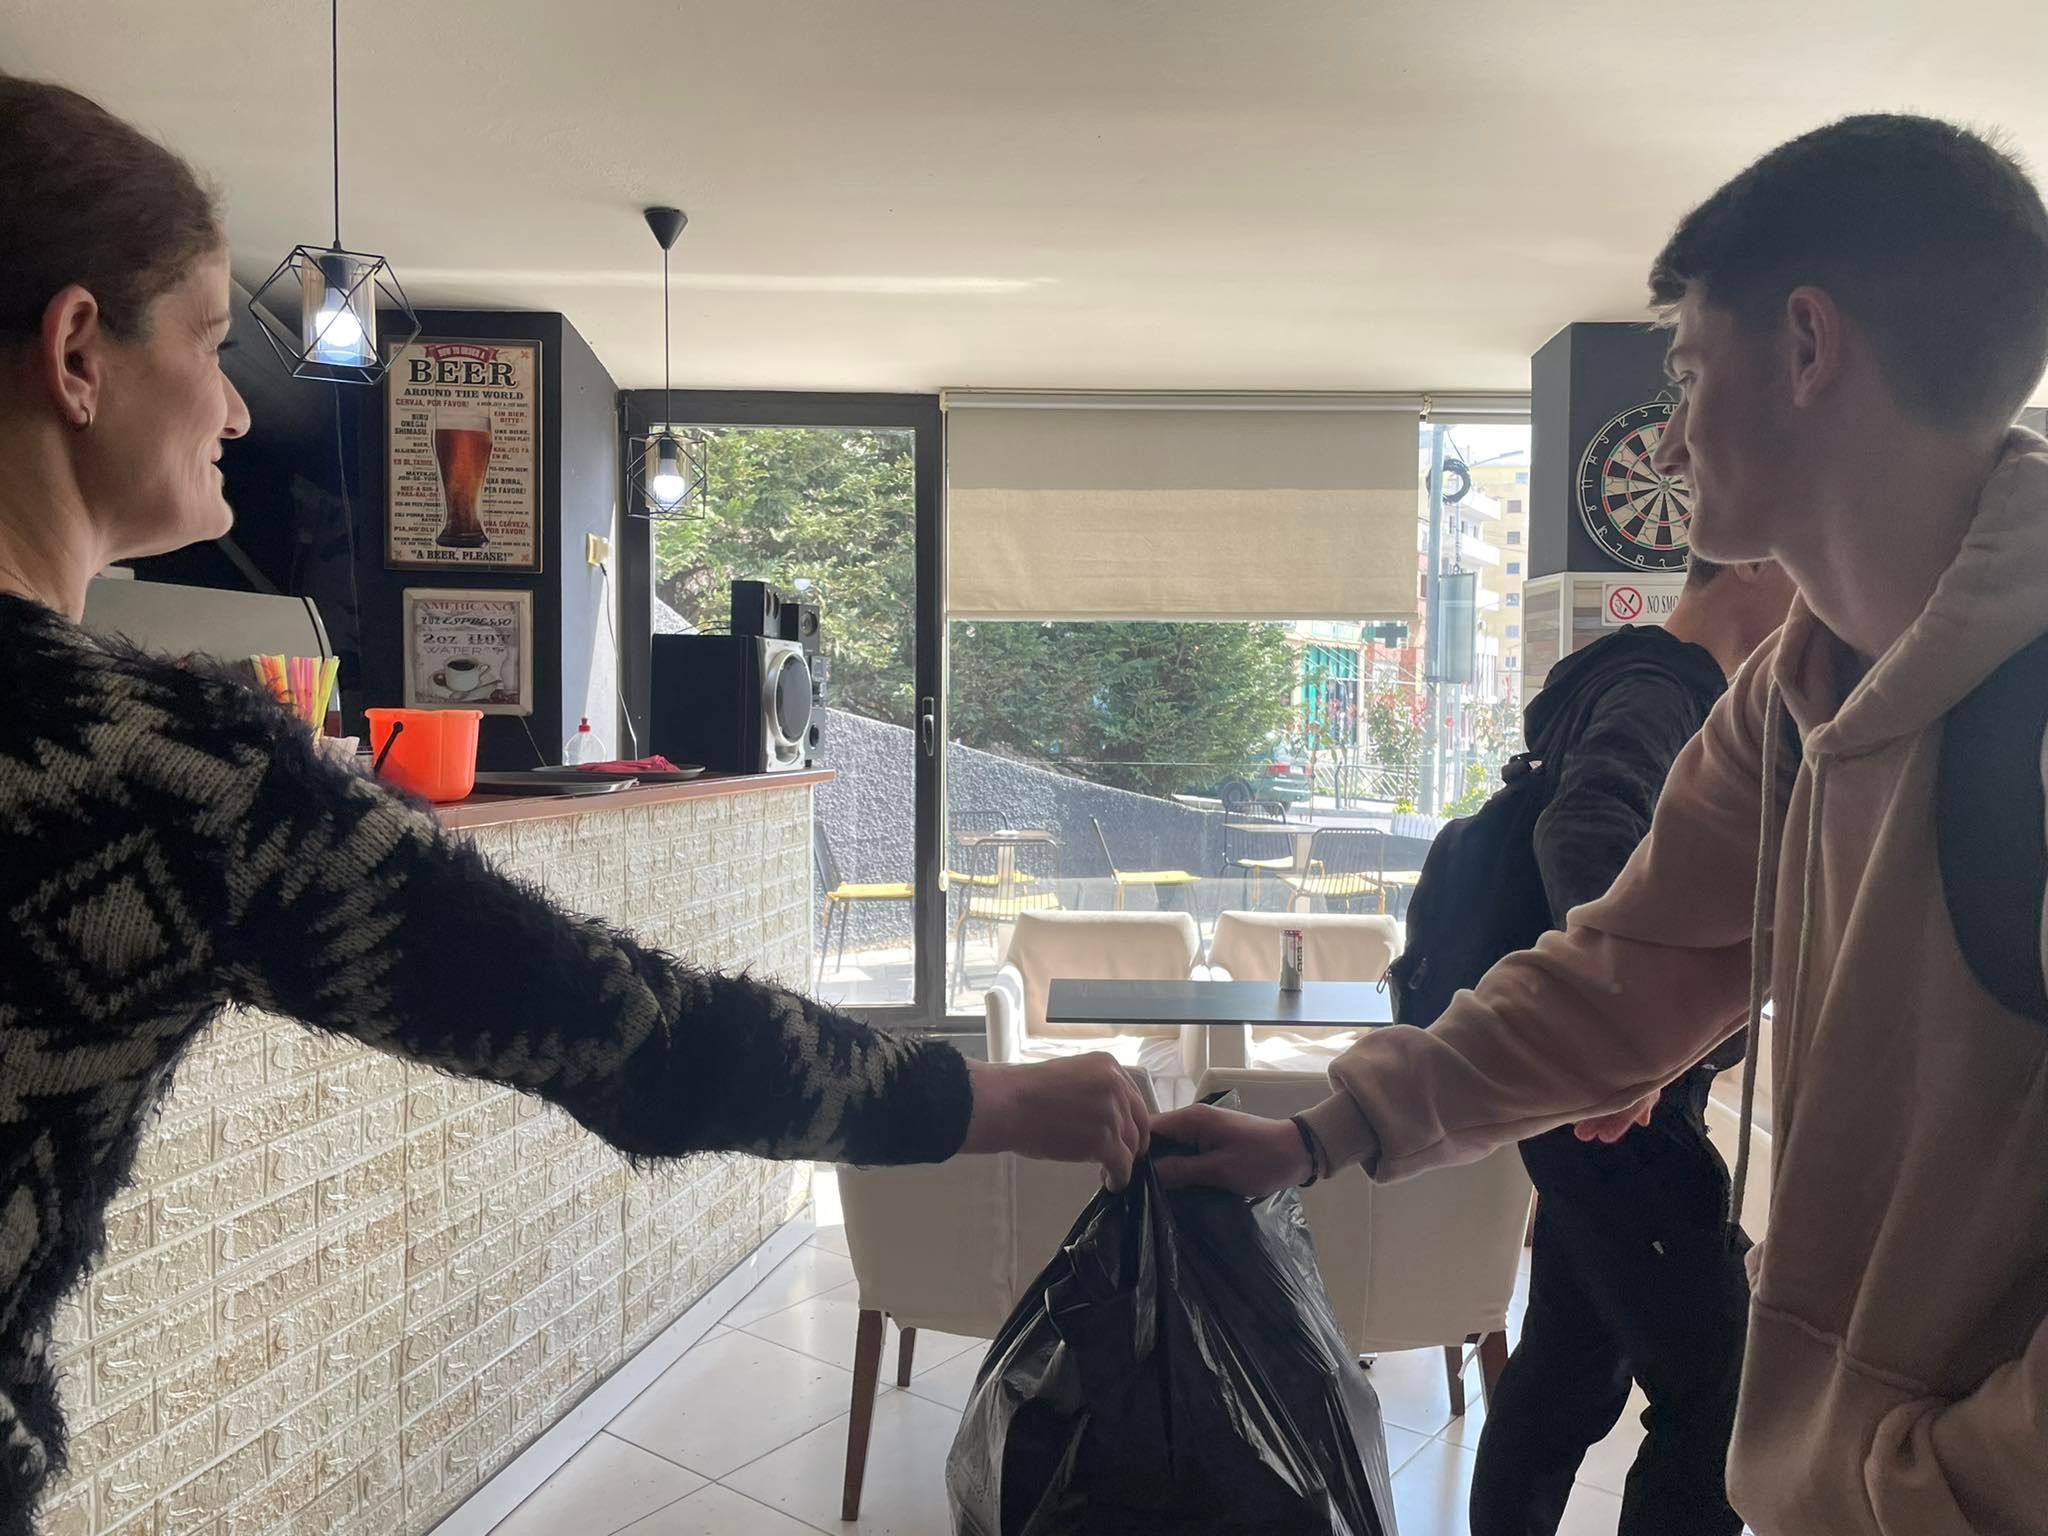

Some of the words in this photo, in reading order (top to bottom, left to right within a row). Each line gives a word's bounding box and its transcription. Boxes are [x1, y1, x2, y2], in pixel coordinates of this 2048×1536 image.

[408, 359, 517, 387] BEER
[404, 388, 452, 397] AROUND
[455, 389, 479, 398] THE
[483, 391, 524, 400] WORLD
[427, 399, 441, 407] POR
[443, 400, 469, 408] FAVOR!
[1640, 408, 1649, 418] 5
[1617, 417, 1629, 428] 12
[486, 477, 499, 485] UNA
[1583, 479, 1593, 488] 11
[499, 487, 526, 495] FAVORE!
[501, 528, 526, 536] FAVOR!
[1614, 543, 1623, 553] 7
[427, 550, 459, 561] BEER,
[462, 551, 514, 561] PLEASE!"
[423, 602, 514, 612] AMERICANO
[1646, 595, 1660, 614] NO
[442, 617, 512, 626] ESPRESSO
[424, 646, 482, 656] WATER
